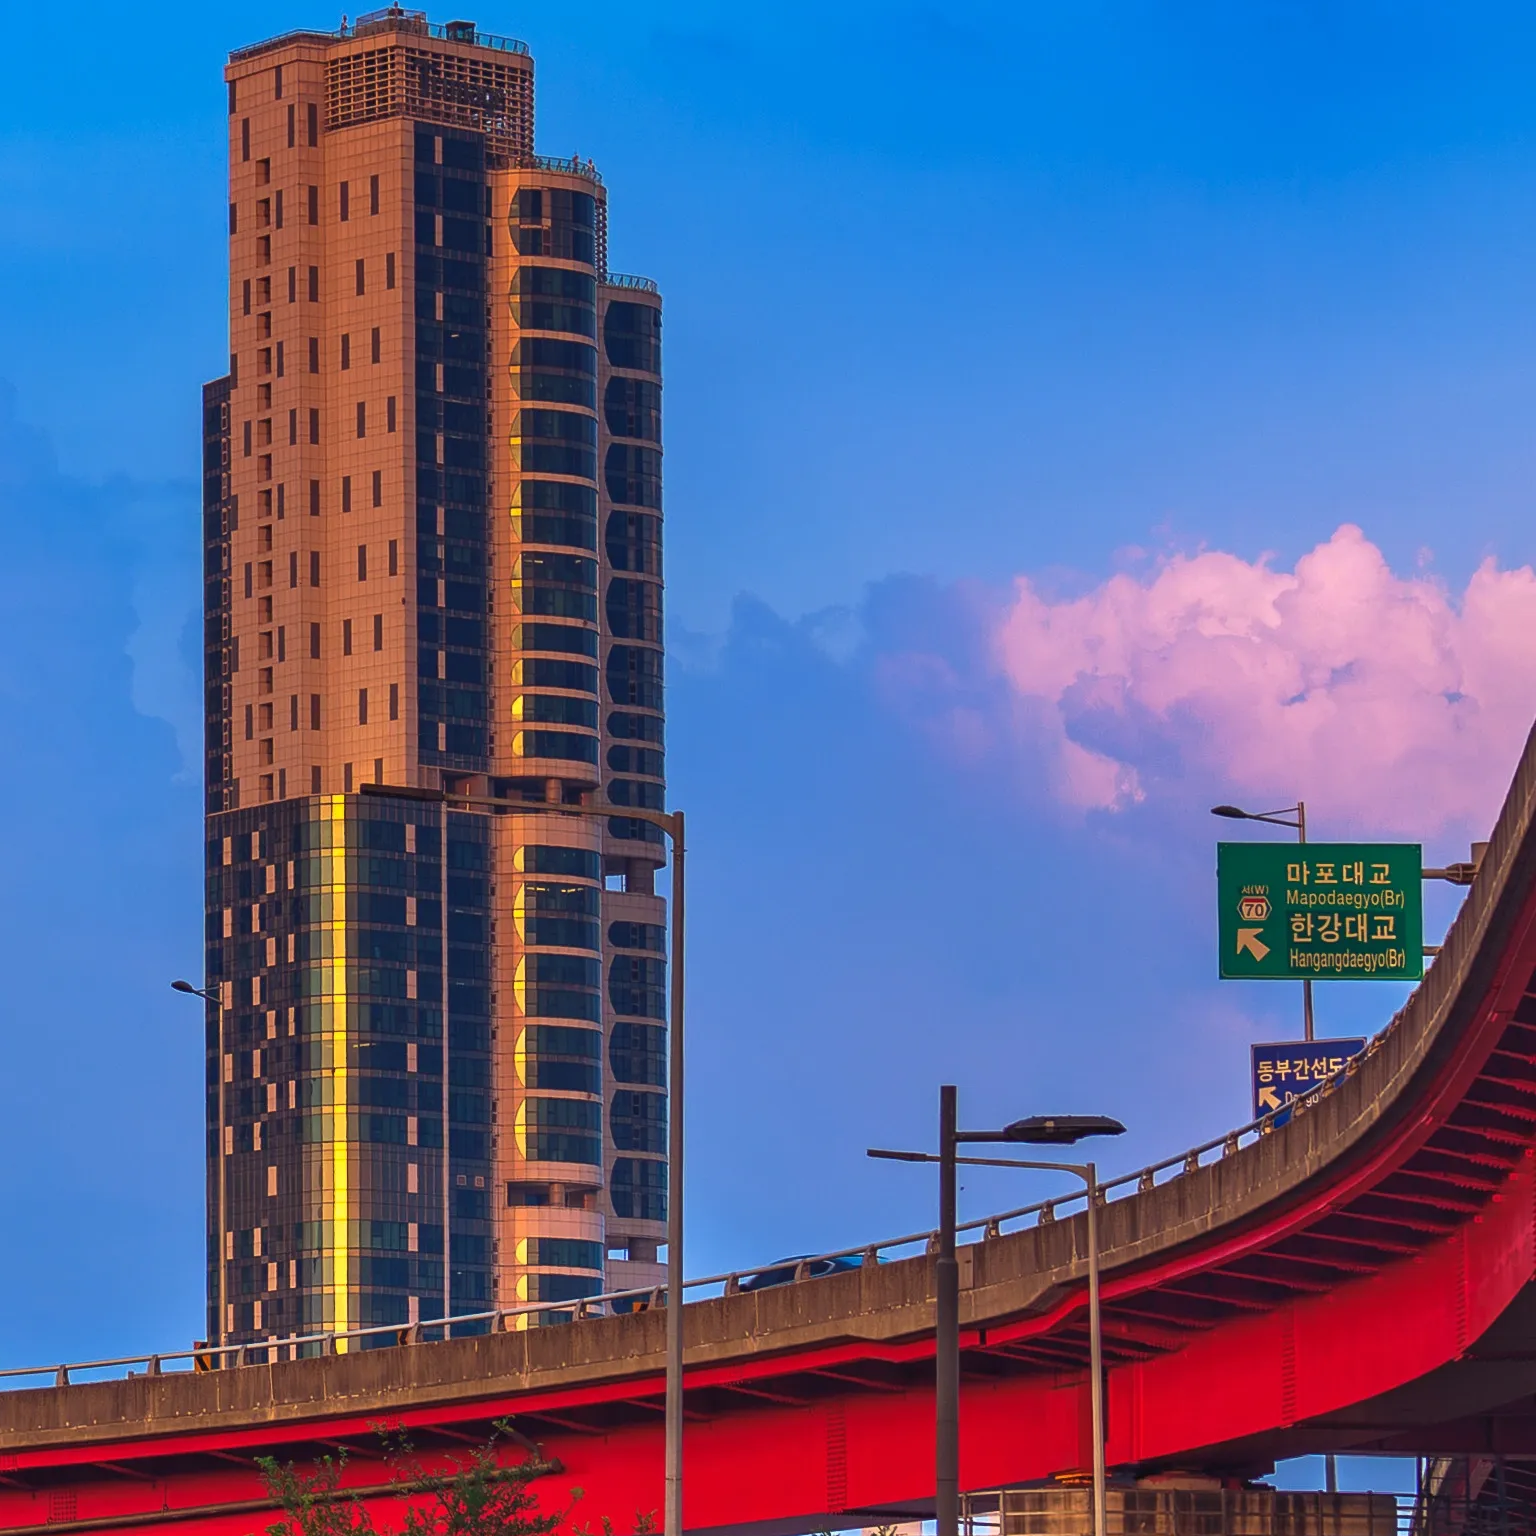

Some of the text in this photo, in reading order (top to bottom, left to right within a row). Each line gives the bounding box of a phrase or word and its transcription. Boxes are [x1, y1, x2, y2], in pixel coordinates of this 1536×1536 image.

[1286, 860, 1392, 886] 마포대교
[1245, 903, 1265, 917] 70
[1286, 889, 1405, 909] Mapodaegyo(Br)
[1289, 912, 1397, 943] 한강대교
[1289, 948, 1406, 972] Hangangdaegyo(Br)
[1257, 1056, 1352, 1082] 동부간선도
